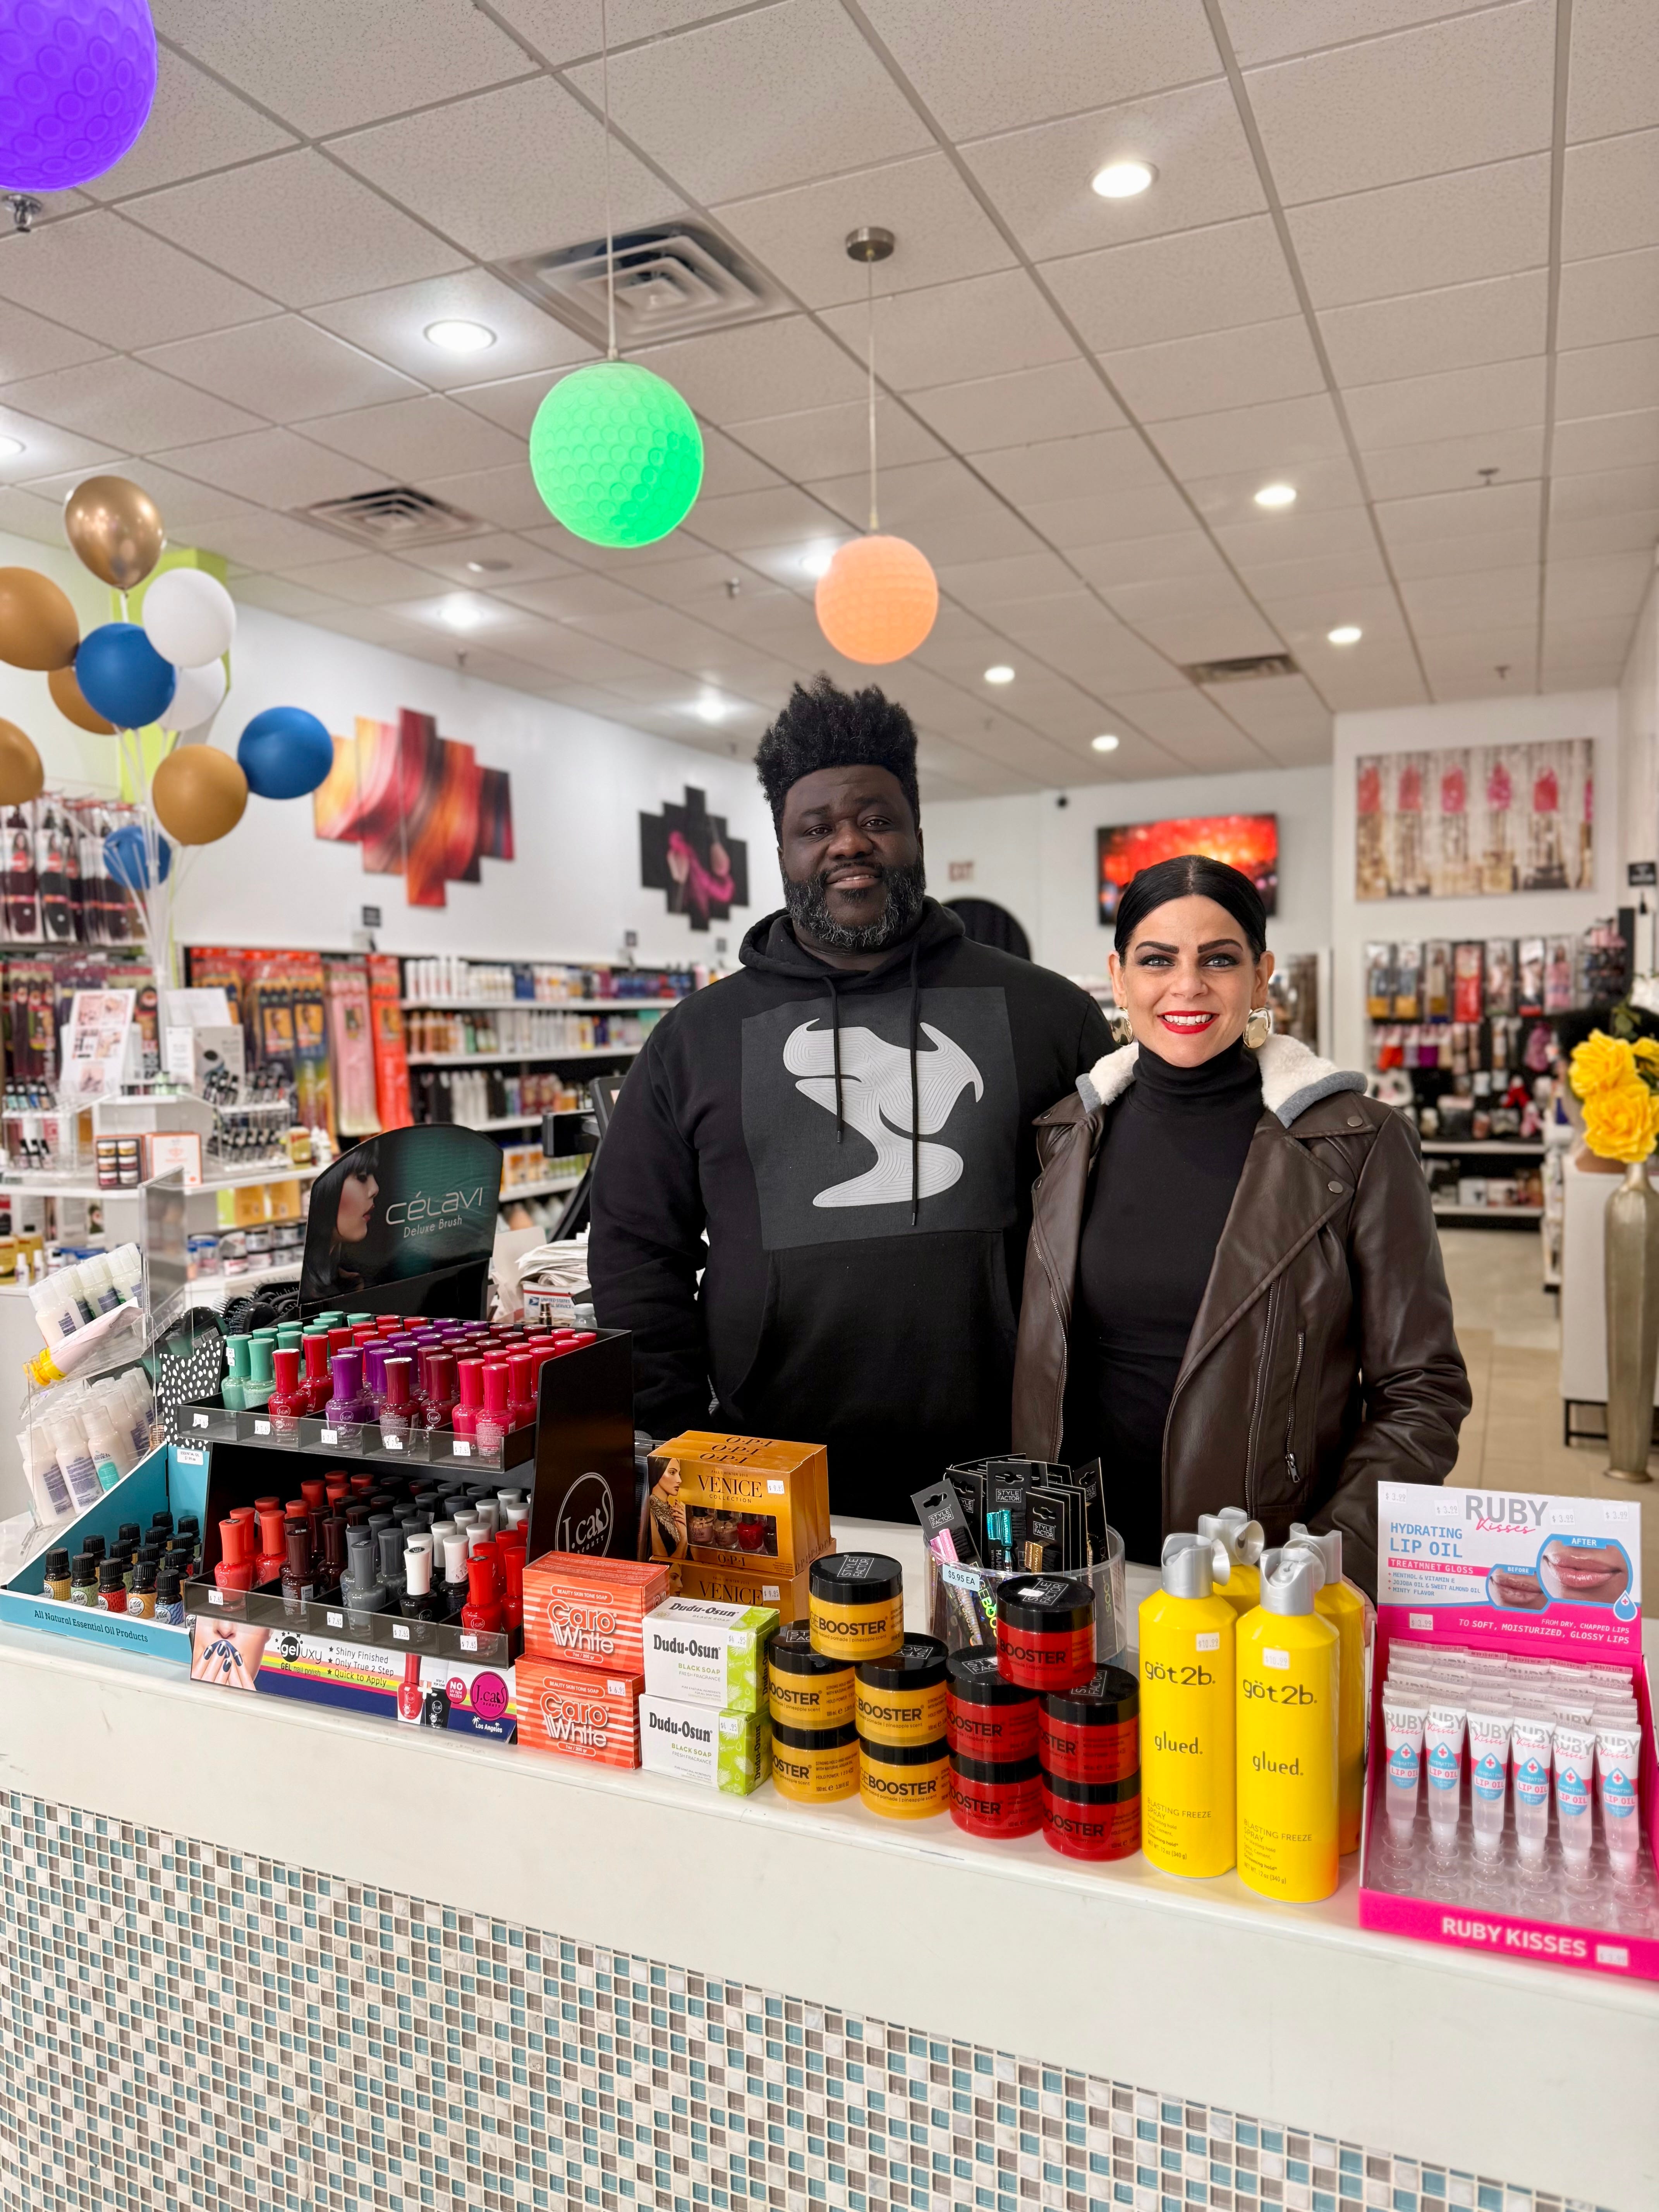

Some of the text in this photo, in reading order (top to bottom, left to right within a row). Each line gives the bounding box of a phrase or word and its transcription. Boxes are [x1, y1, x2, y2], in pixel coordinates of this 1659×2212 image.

[404, 1215, 462, 1238] Deluxe Brush
[697, 1475, 762, 1498] VENICE
[709, 1494, 751, 1503] COLLECTION
[929, 1509, 950, 1522] STYLE
[1465, 1495, 1548, 1526] RUBY
[932, 1514, 953, 1527] FACTOR
[1035, 1523, 1053, 1532] STYLE
[1476, 1516, 1535, 1534] Kisses
[1034, 1528, 1054, 1538] FACTOR
[1391, 1522, 1463, 1539] HYDRATING
[1390, 1537, 1463, 1558] LIP OIL
[1571, 1537, 1597, 1546] AFTER
[841, 1558, 859, 1576] STYLE
[853, 1559, 871, 1577] FACTOR
[1391, 1559, 1474, 1574] TREATMNET GLOSS
[948, 1570, 975, 1585] $5.95 EA
[72, 1594, 85, 1602] Wild
[1039, 1583, 1065, 1604] FACTOR
[129, 1600, 142, 1608] Wild
[668, 1602, 736, 1617] Dudu-Osun
[156, 1611, 167, 1619] Wild
[547, 1599, 615, 1634] Caro
[34, 1610, 148, 1642] All Natural Essential Oil Products
[1472, 1620, 1497, 1631] SOFT,
[1501, 1623, 1566, 1638] MOISTURIZED,
[1570, 1631, 1604, 1642] GLOSSY
[1607, 1635, 1630, 1644] LIPS
[1561, 1621, 1576, 1629] DRY,
[1580, 1623, 1610, 1632] CHAPPED
[550, 1621, 614, 1654] White
[336, 1647, 388, 1664] Shiny Finished
[653, 1634, 719, 1660] Dudu-Osun
[281, 1662, 321, 1677] GEL nail polish
[335, 1658, 351, 1669] Only
[354, 1661, 369, 1671] True
[378, 1666, 394, 1677] Step
[678, 1662, 720, 1675] BLACK SOAP
[335, 1669, 354, 1680] Quick
[366, 1677, 386, 1688] Apply
[450, 1681, 463, 1691] NO
[694, 1673, 721, 1682] FRAGRANCE
[540, 1691, 608, 1727] Caro
[484, 1724, 502, 1733] Angeles
[649, 1712, 711, 1743] Dudu-Osun
[1386, 1712, 1427, 1730] RUBY
[1469, 1719, 1511, 1740] RUBY
[544, 1714, 607, 1747] White
[1391, 1725, 1422, 1735] Kisses
[1154, 1730, 1203, 1755] glued.
[1474, 1735, 1506, 1745] Kisses
[672, 1743, 712, 1758] BLACK SOAP
[686, 1755, 712, 1765] FRAGRANCE
[774, 1754, 809, 1779] OSTER
[1252, 1750, 1304, 1776] glued.
[1390, 1767, 1405, 1776] LIP
[1429, 1767, 1442, 1776] LIP
[1475, 1778, 1489, 1786] LIP
[1518, 1781, 1532, 1791] LIP
[1147, 1796, 1180, 1816] BLASTING
[1558, 1791, 1587, 1804] LIP OIL
[1147, 1805, 1166, 1820] SPRAY
[1244, 1818, 1312, 1841] BLASTING FREEZE
[1244, 1826, 1264, 1843] SPRAY
[1442, 1917, 1587, 1957] RUBY KISSES
